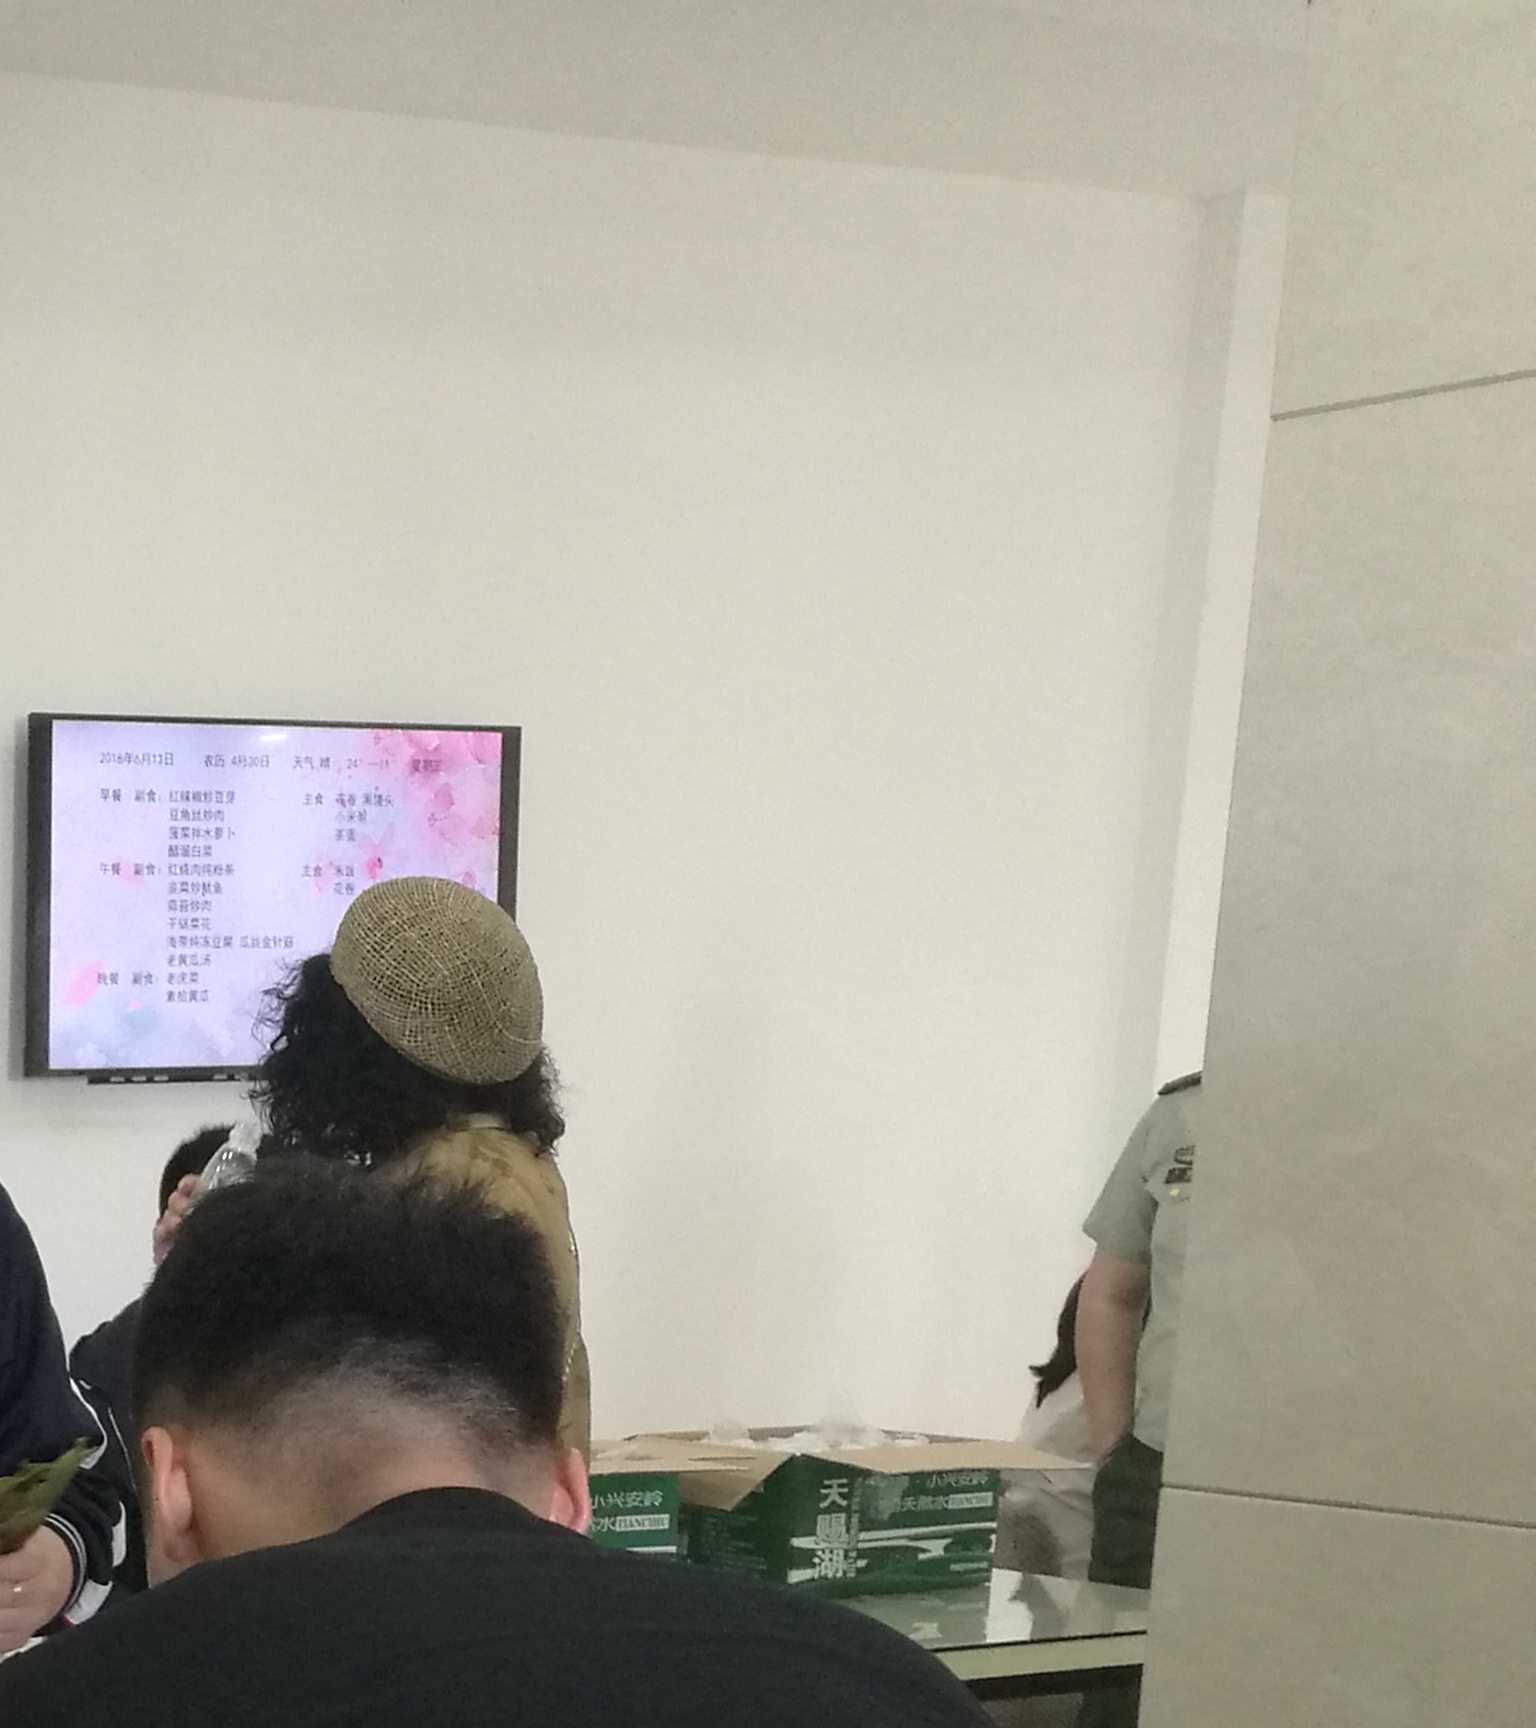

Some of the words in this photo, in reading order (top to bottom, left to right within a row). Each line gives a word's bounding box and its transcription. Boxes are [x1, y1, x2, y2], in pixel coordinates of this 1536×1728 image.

[99, 752, 174, 767] 2018年6月13日
[292, 756, 315, 769] 天气
[100, 788, 121, 802] 早餐
[302, 792, 324, 806] 主食
[100, 862, 121, 876] 午餐
[301, 864, 323, 878] 主食
[97, 971, 119, 986] 晚餐
[812, 1478, 849, 1579] 天赐湖
